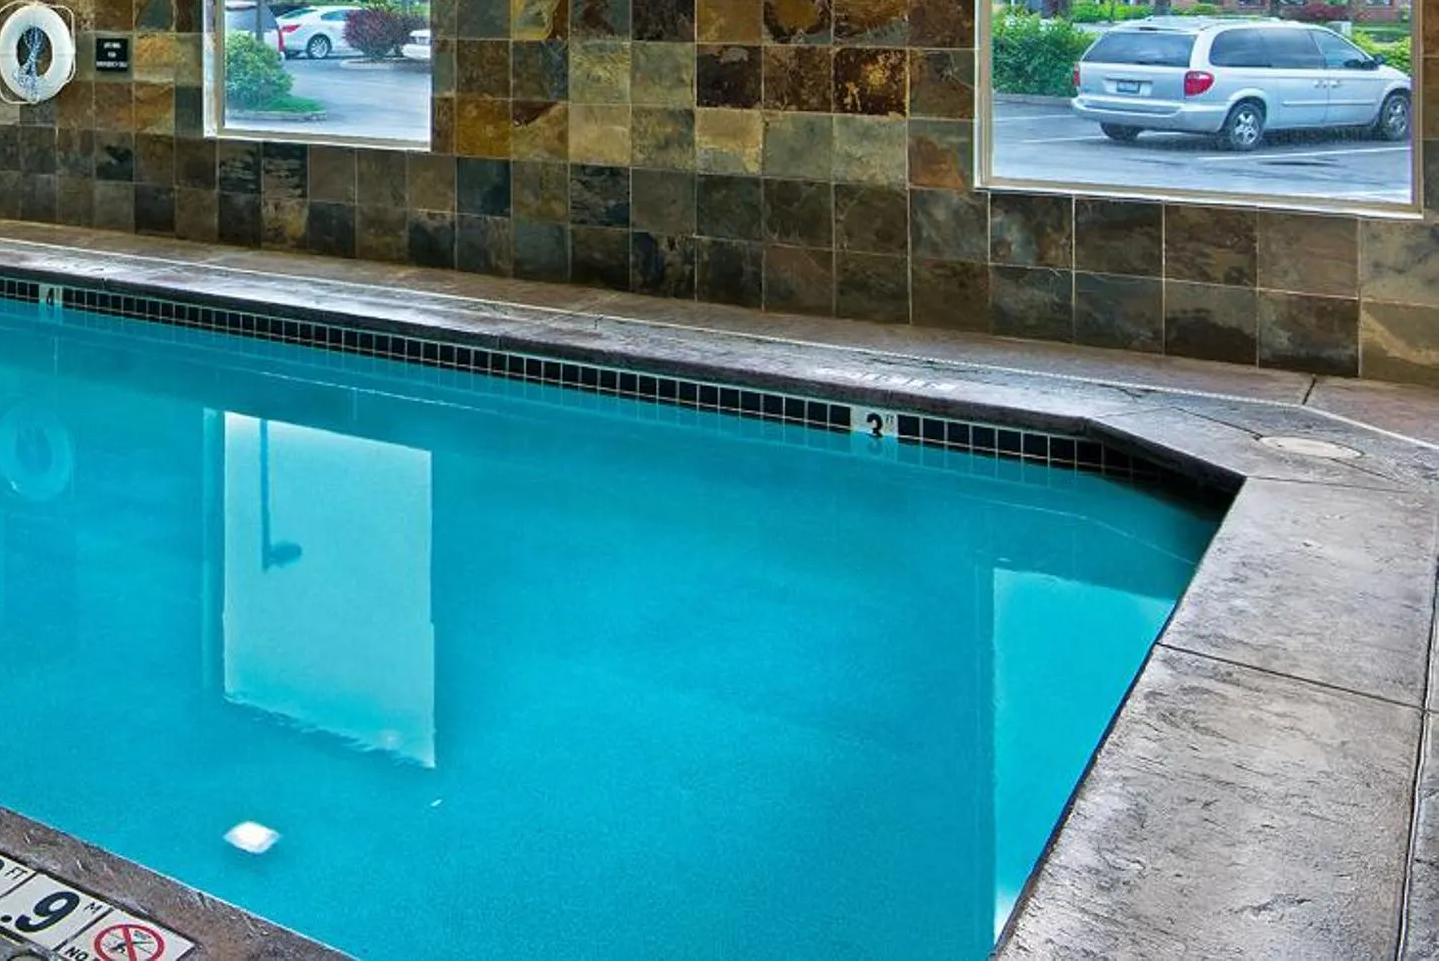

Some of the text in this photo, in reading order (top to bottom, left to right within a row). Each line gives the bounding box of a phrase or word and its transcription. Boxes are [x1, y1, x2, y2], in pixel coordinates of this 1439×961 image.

[5, 867, 28, 879] FT
[83, 902, 103, 914] M
[65, 946, 90, 961] NO
